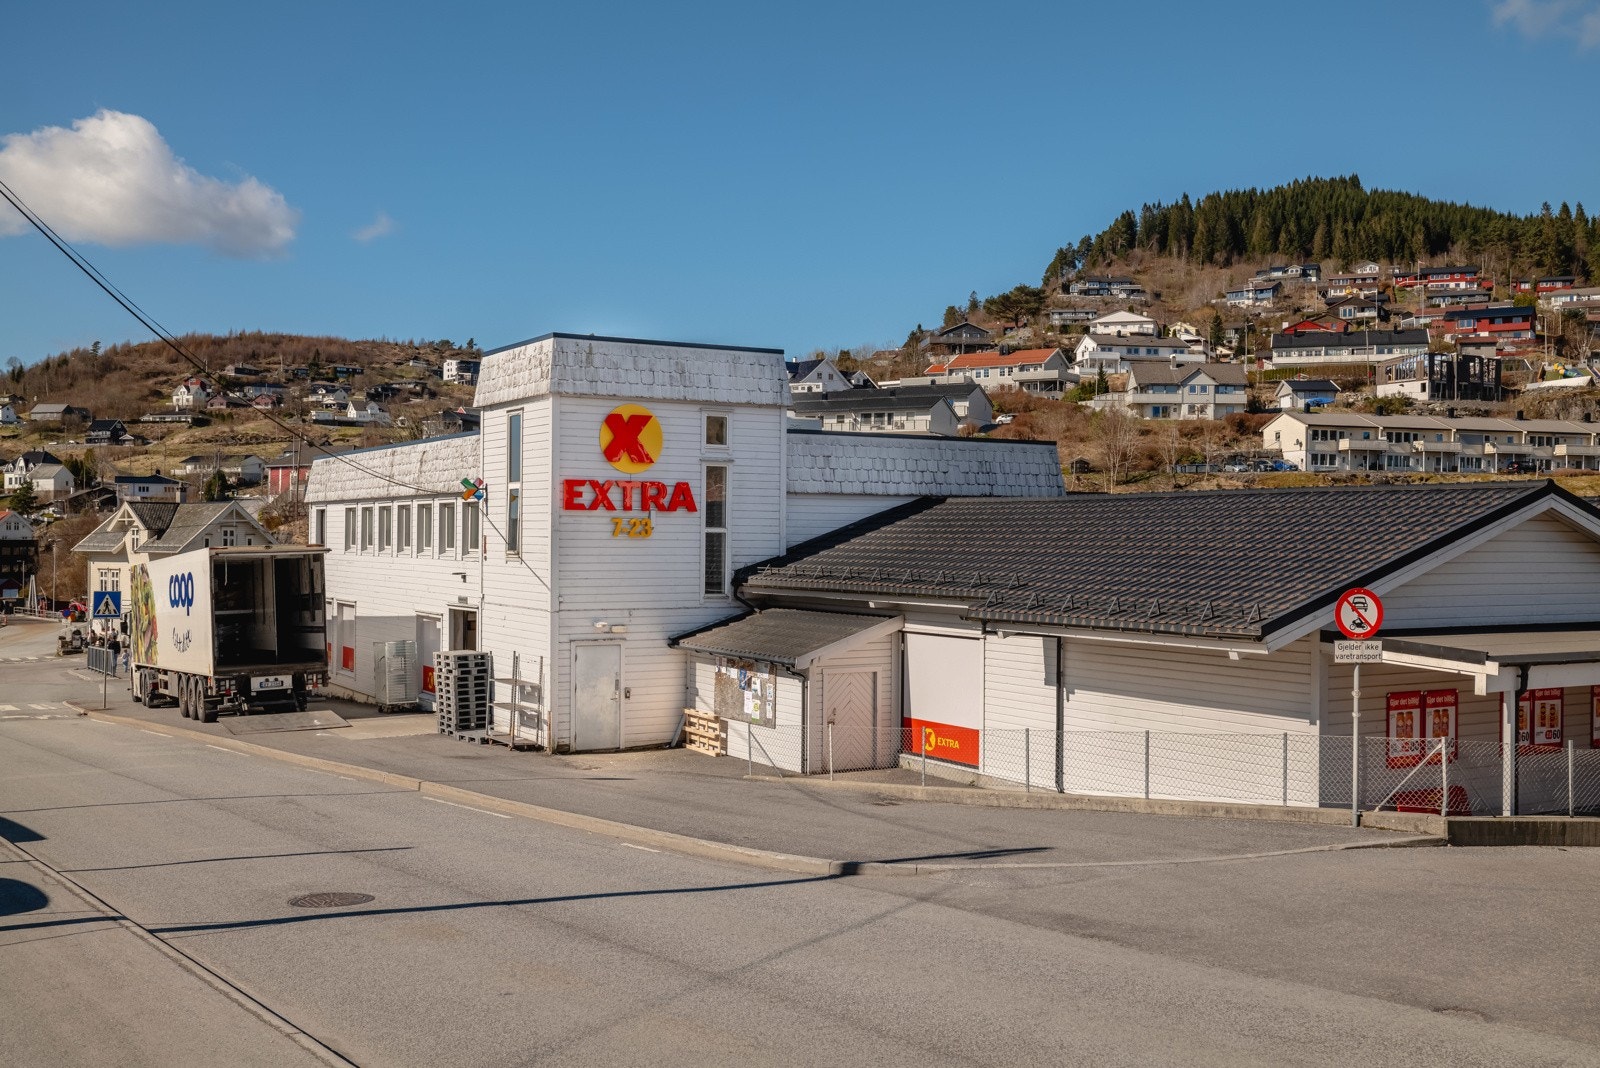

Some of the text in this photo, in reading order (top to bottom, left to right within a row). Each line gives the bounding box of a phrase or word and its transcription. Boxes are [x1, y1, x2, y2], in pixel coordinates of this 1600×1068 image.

[563, 479, 698, 512] EXTRA
[611, 517, 653, 539] 7-23
[169, 571, 194, 616] coop
[1337, 643, 1379, 652] Gjelder ikke
[1335, 653, 1382, 661] varetransport
[1521, 732, 1530, 741] 60
[1553, 730, 1561, 739] 60
[937, 737, 959, 749] EXTRA
